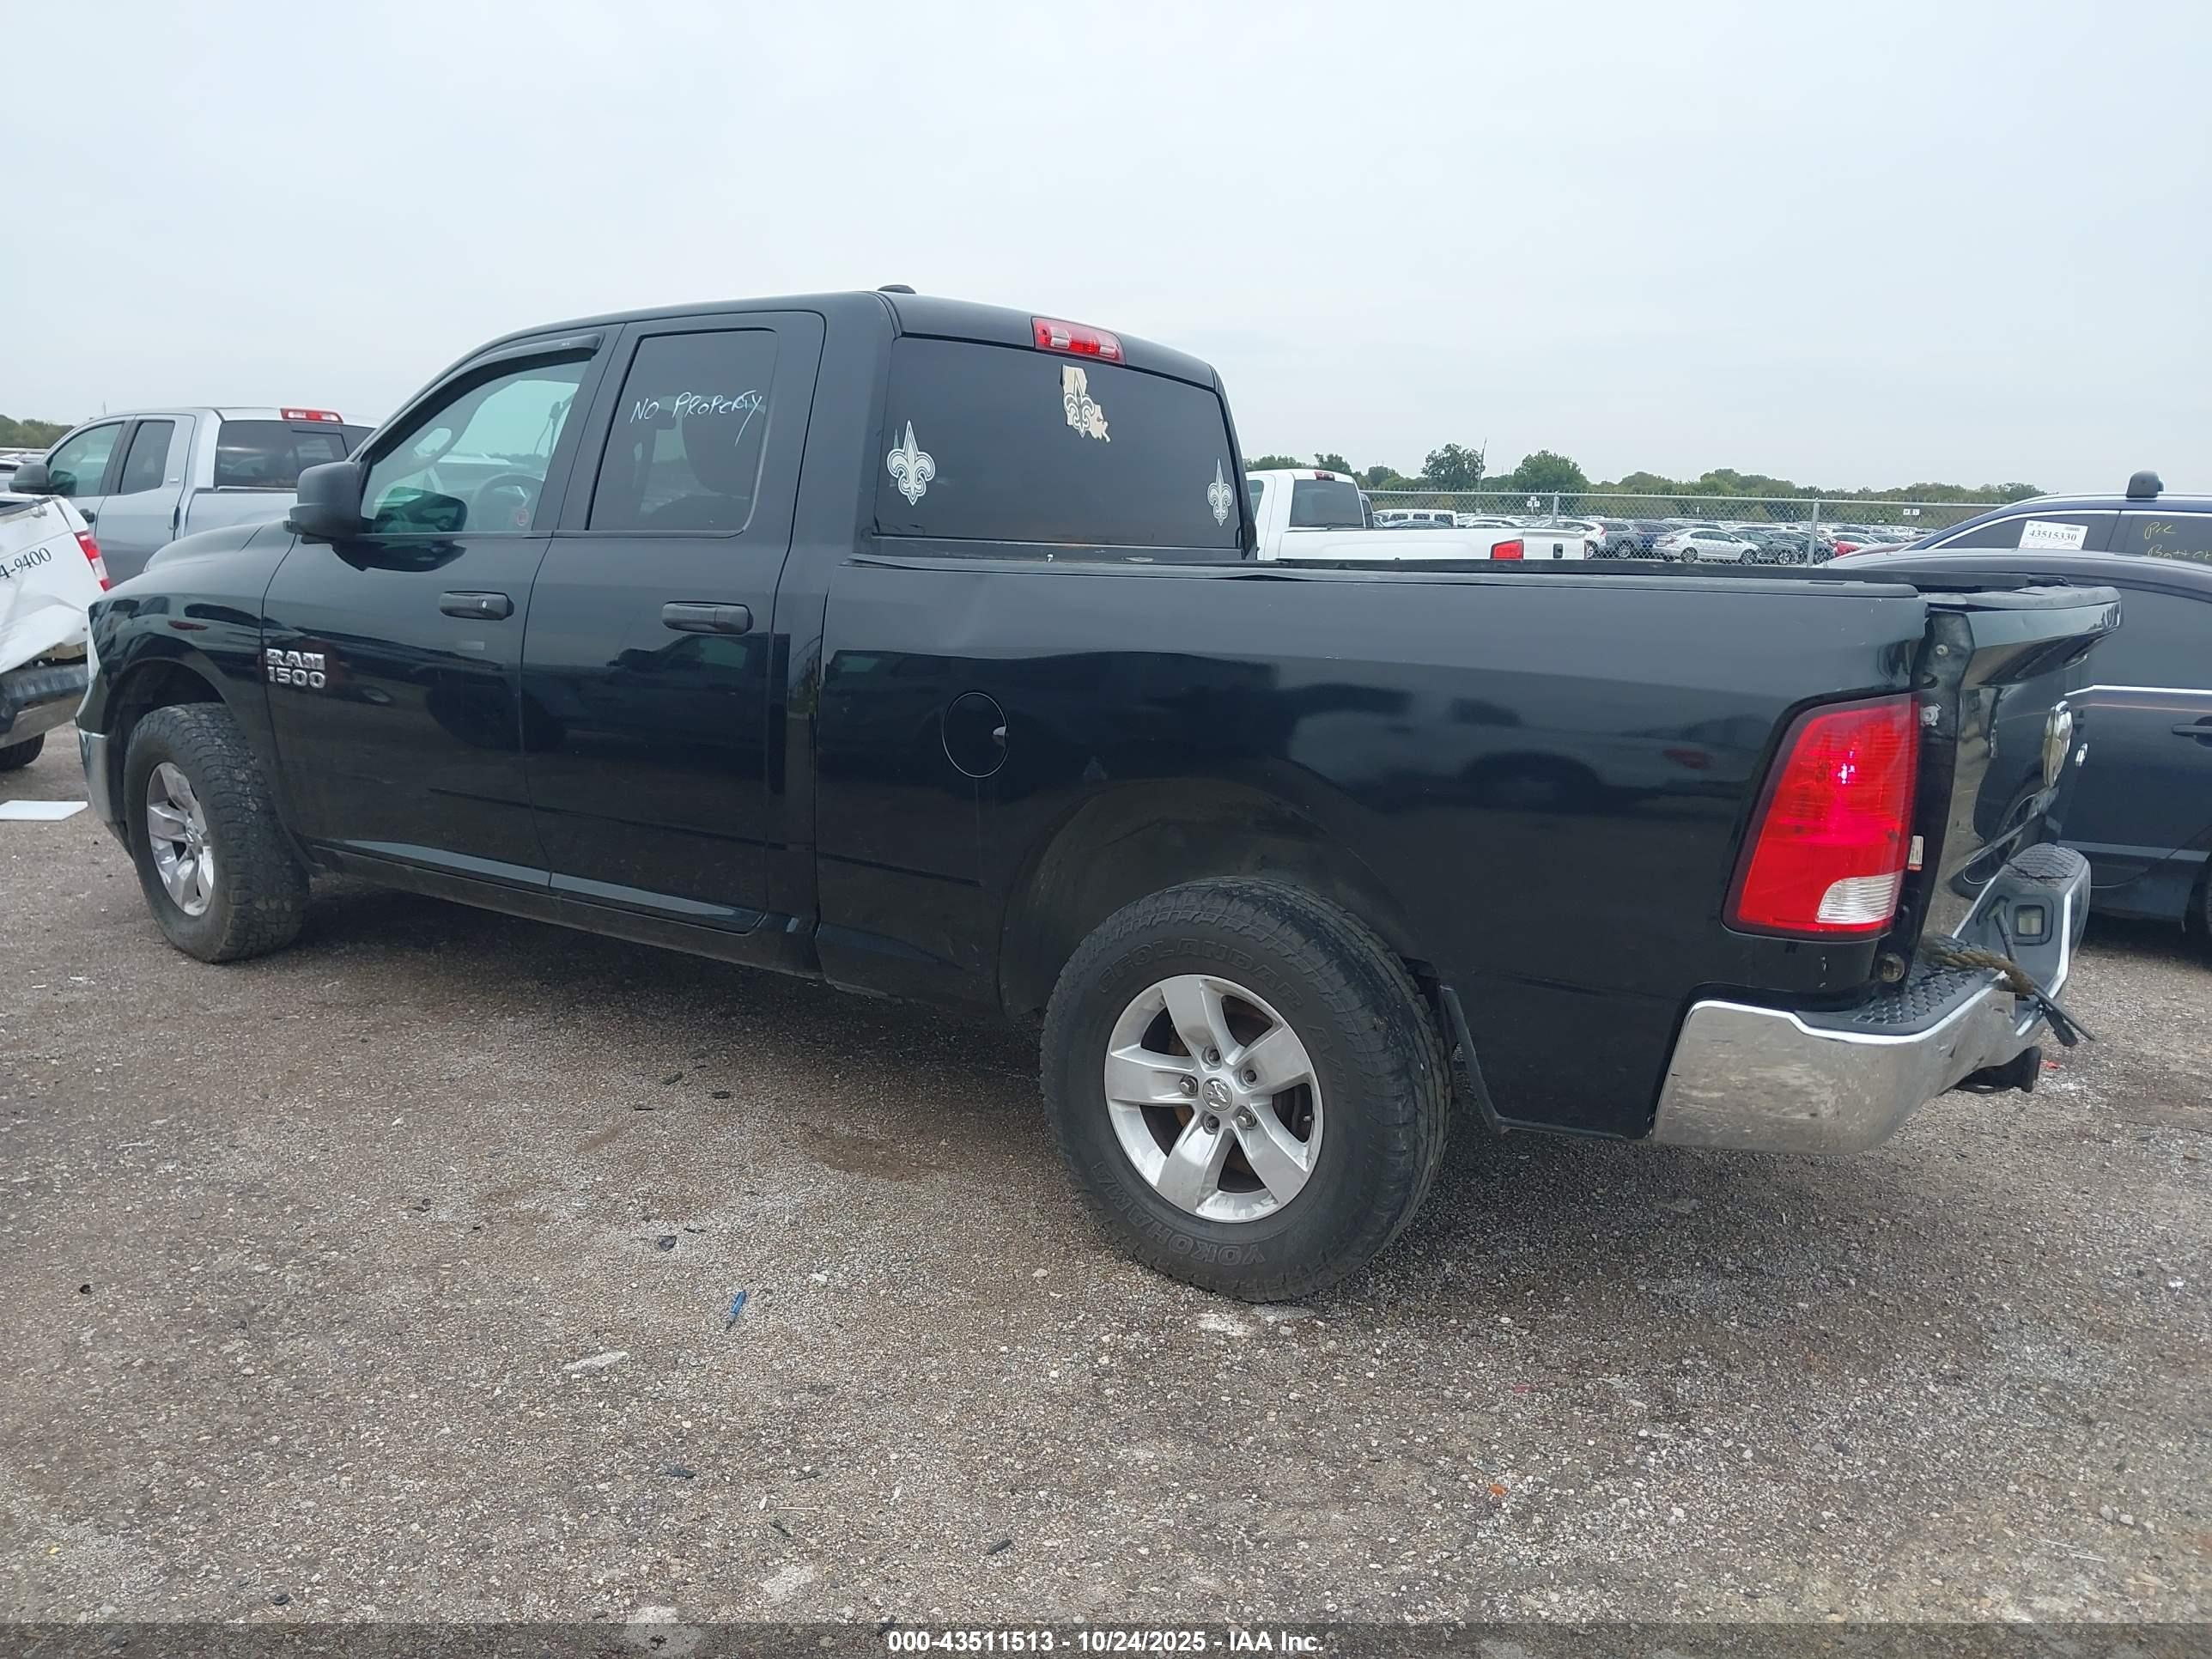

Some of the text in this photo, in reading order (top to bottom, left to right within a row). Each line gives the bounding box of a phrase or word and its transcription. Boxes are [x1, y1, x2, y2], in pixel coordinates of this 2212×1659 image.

[630, 398, 659, 423] NO
[2027, 529, 2078, 542] 43515330
[0, 547, 52, 579] 4-9400
[266, 647, 325, 671] RAM
[267, 665, 326, 689] 1500
[1091, 1162, 1267, 1267] YOKOHAMA
